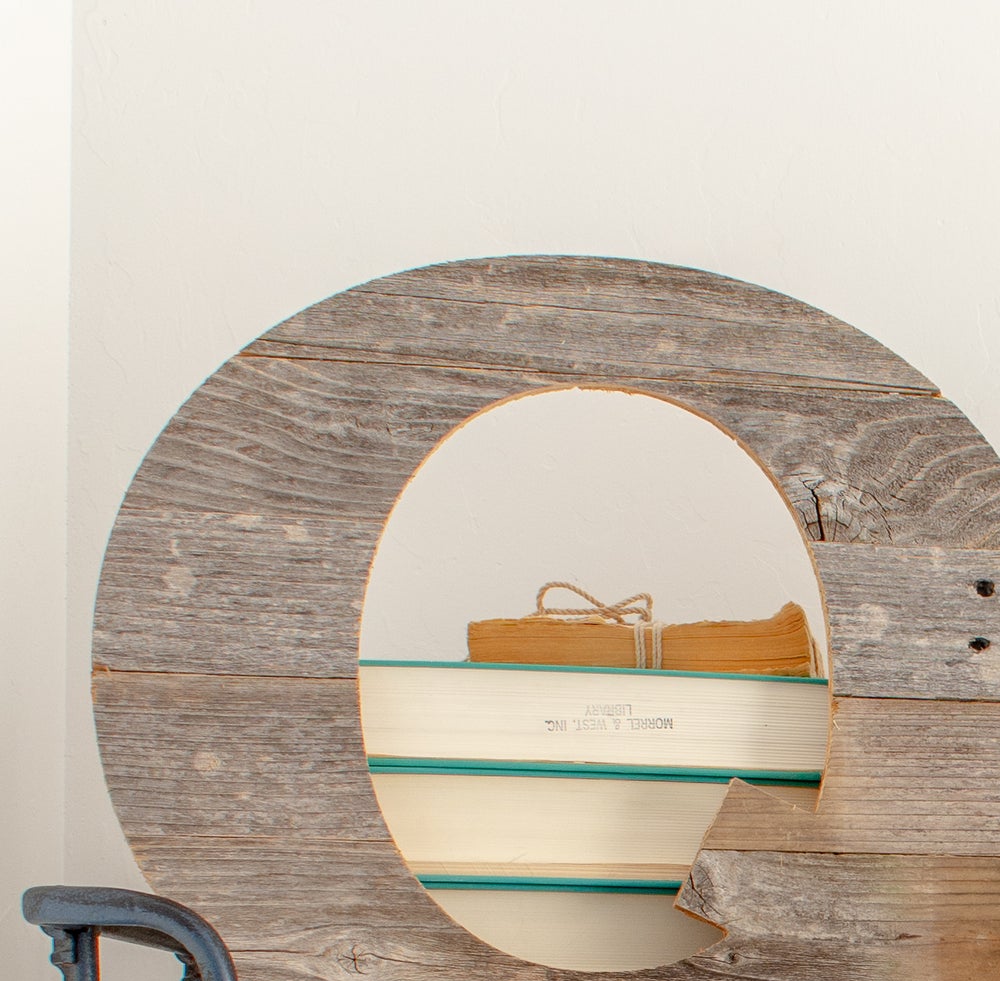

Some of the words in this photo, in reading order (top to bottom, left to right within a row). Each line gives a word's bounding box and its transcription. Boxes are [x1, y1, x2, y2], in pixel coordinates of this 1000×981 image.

[584, 703, 633, 717] LIBRARY
[611, 718, 622, 731] &
[626, 718, 674, 730] MORREL
